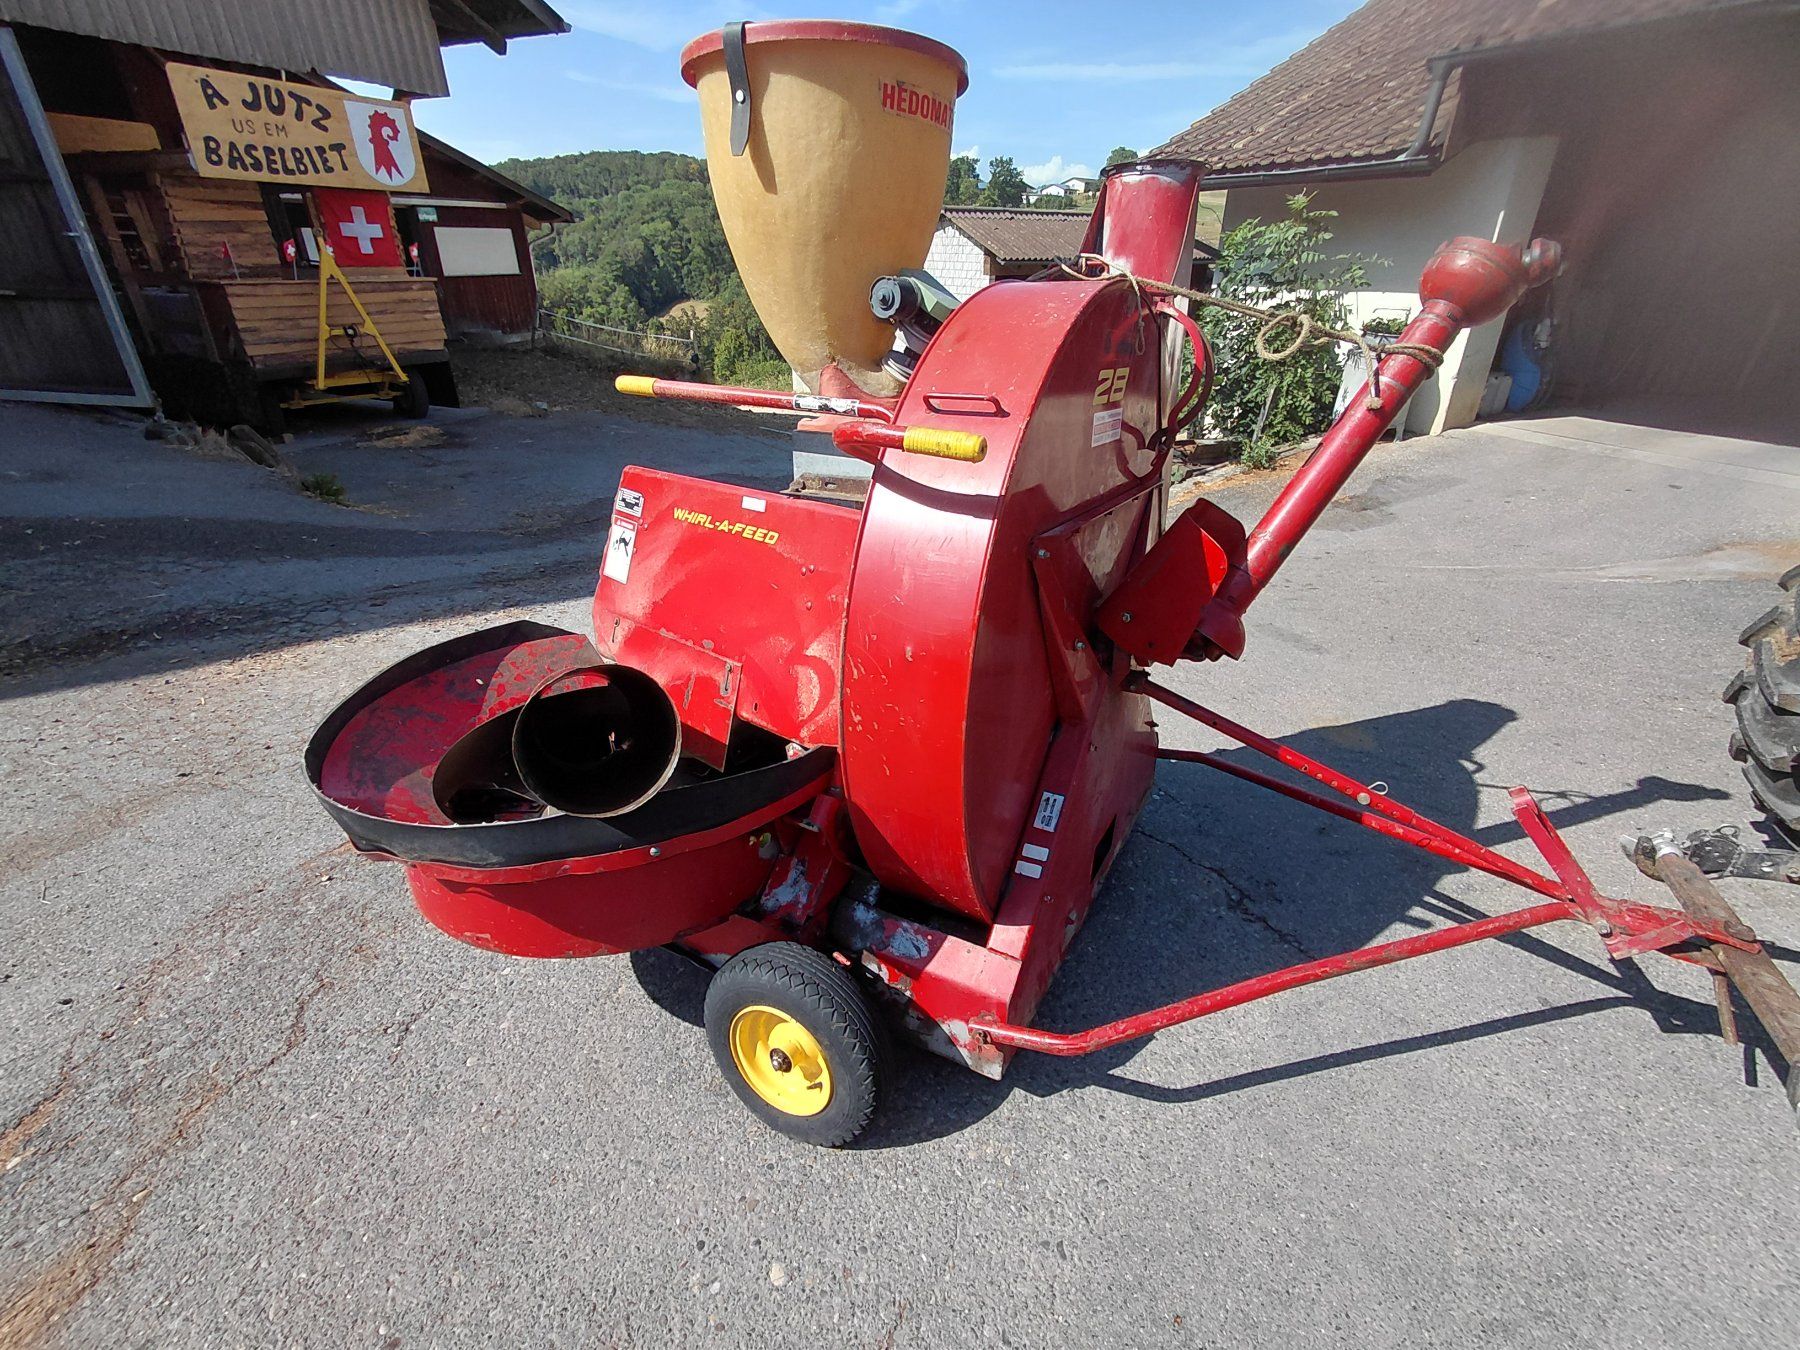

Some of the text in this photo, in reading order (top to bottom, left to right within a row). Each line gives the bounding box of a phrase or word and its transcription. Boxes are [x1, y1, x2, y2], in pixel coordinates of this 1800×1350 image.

[241, 81, 331, 133] JUTZ
[231, 118, 288, 138] US EM
[203, 135, 349, 176] BASELBIET
[1093, 367, 1130, 405] 28
[673, 507, 780, 545] WHIRL-A-FEED
